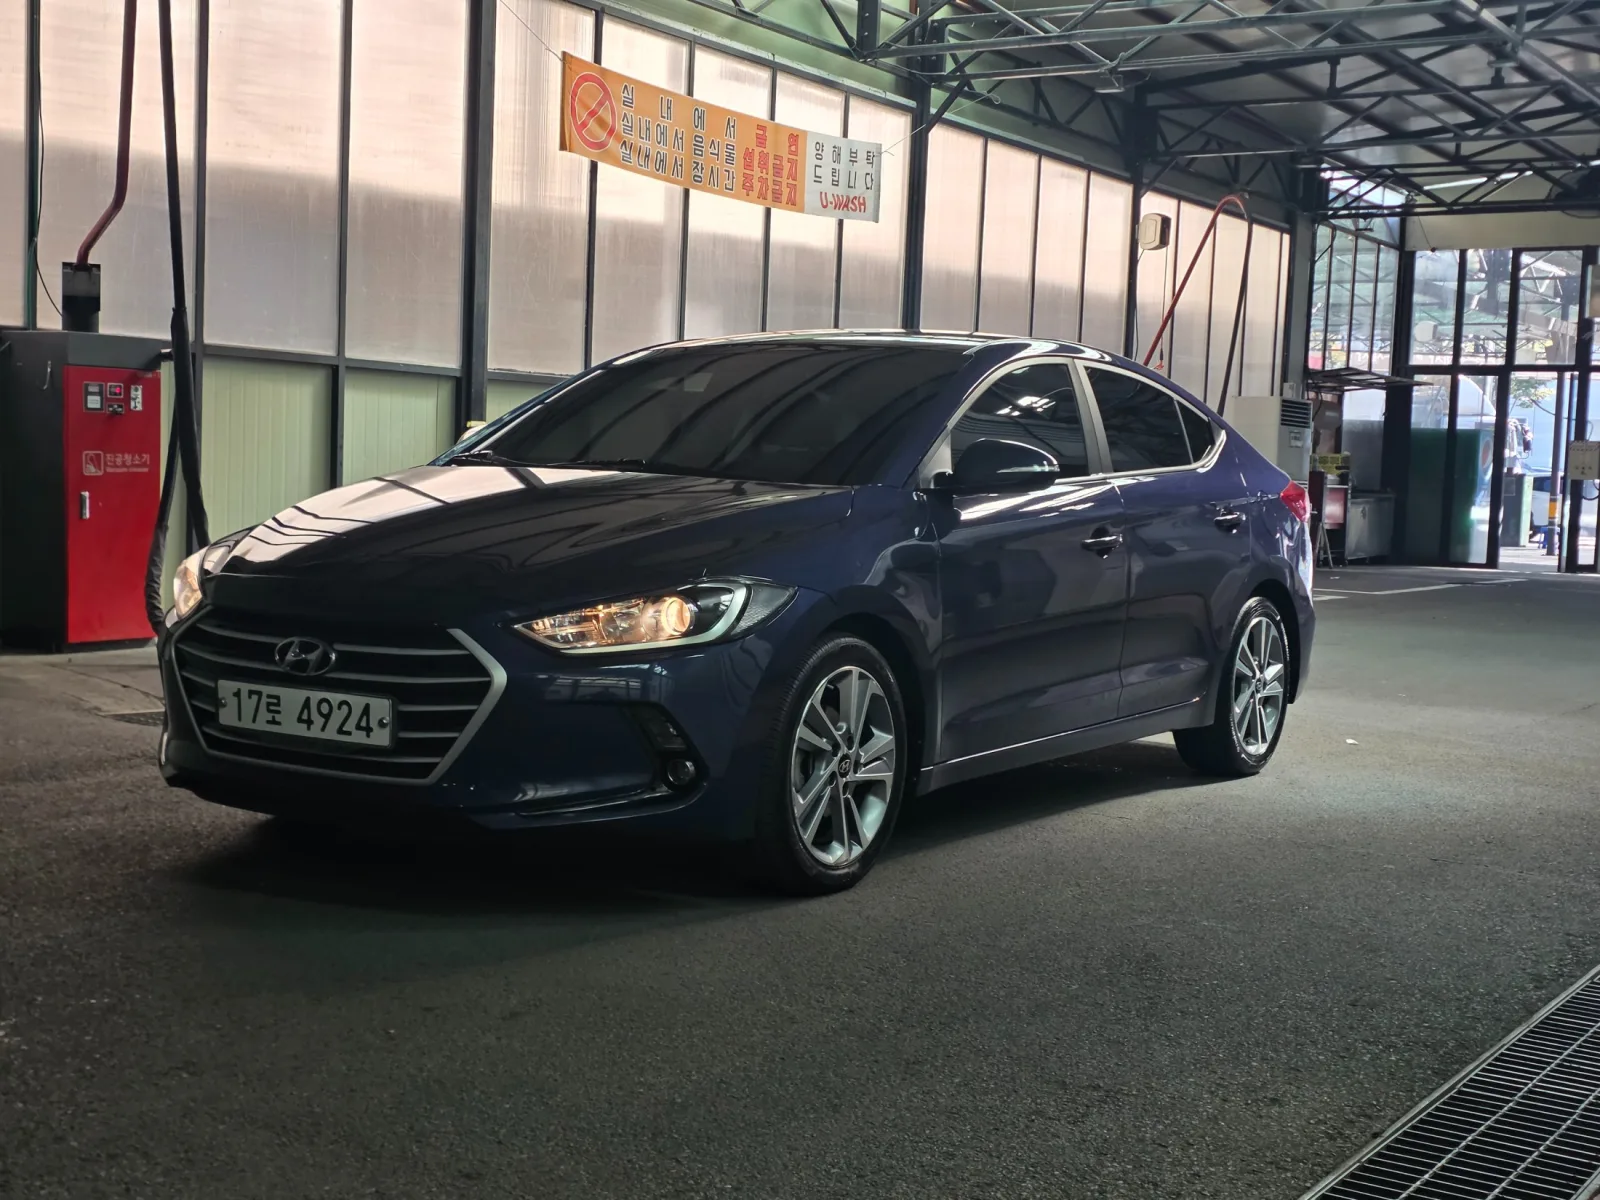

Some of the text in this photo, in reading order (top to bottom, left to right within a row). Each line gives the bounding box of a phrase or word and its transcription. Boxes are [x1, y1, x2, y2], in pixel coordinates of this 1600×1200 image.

[621, 111, 685, 152] 실내에서
[692, 134, 736, 166] 음식물
[619, 139, 797, 207] 실내에서 장시간 주차금지
[819, 191, 867, 213] U-WASH
[105, 453, 150, 466] 진공청소기
[232, 687, 374, 739] 17로 4924
